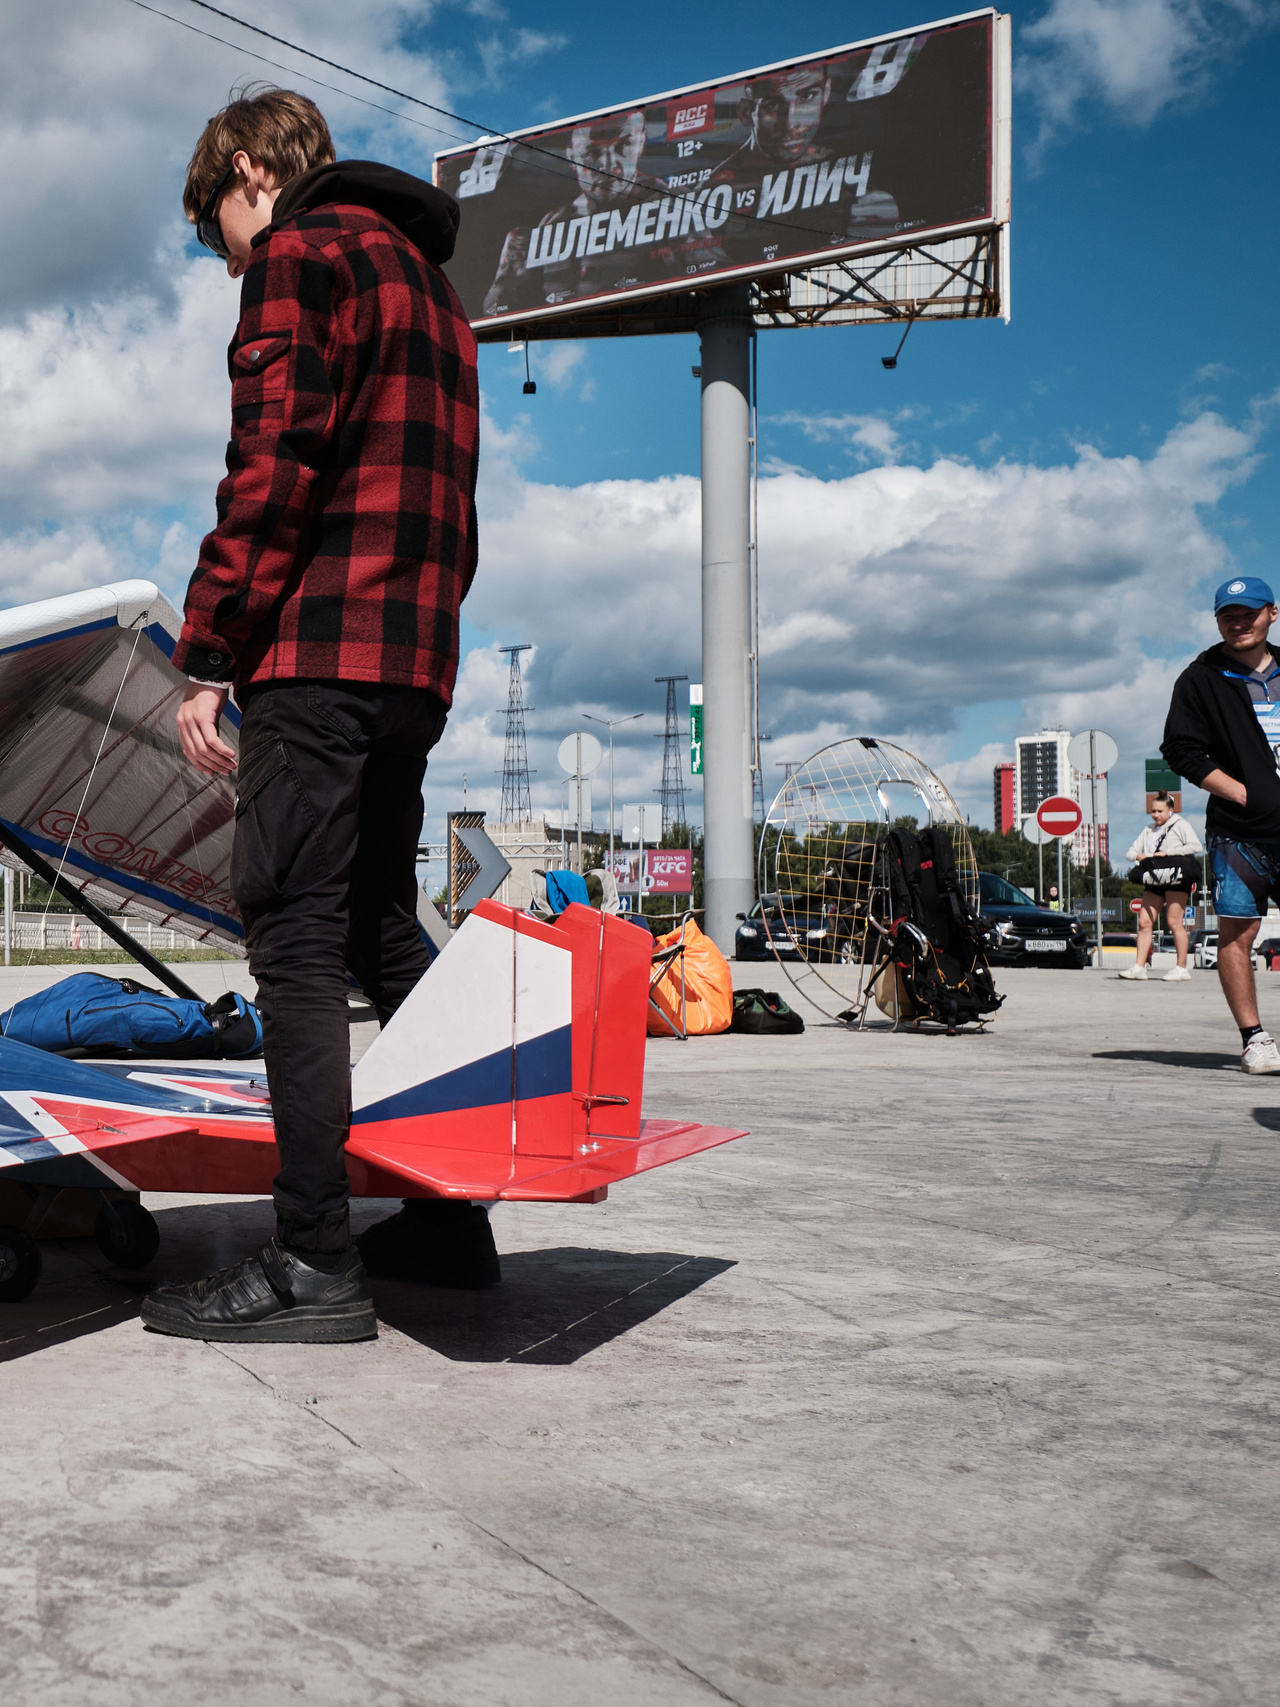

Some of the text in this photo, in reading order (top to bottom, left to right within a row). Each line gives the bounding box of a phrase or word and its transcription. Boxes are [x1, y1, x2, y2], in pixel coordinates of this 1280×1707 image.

[676, 139, 704, 159] 12+
[667, 168, 712, 189] RCC 12
[525, 183, 734, 269] ШЛЕМЕНКО
[755, 150, 874, 219] ИЛИЧ
[38, 810, 242, 920] COMBA
[652, 861, 687, 874] KFC
